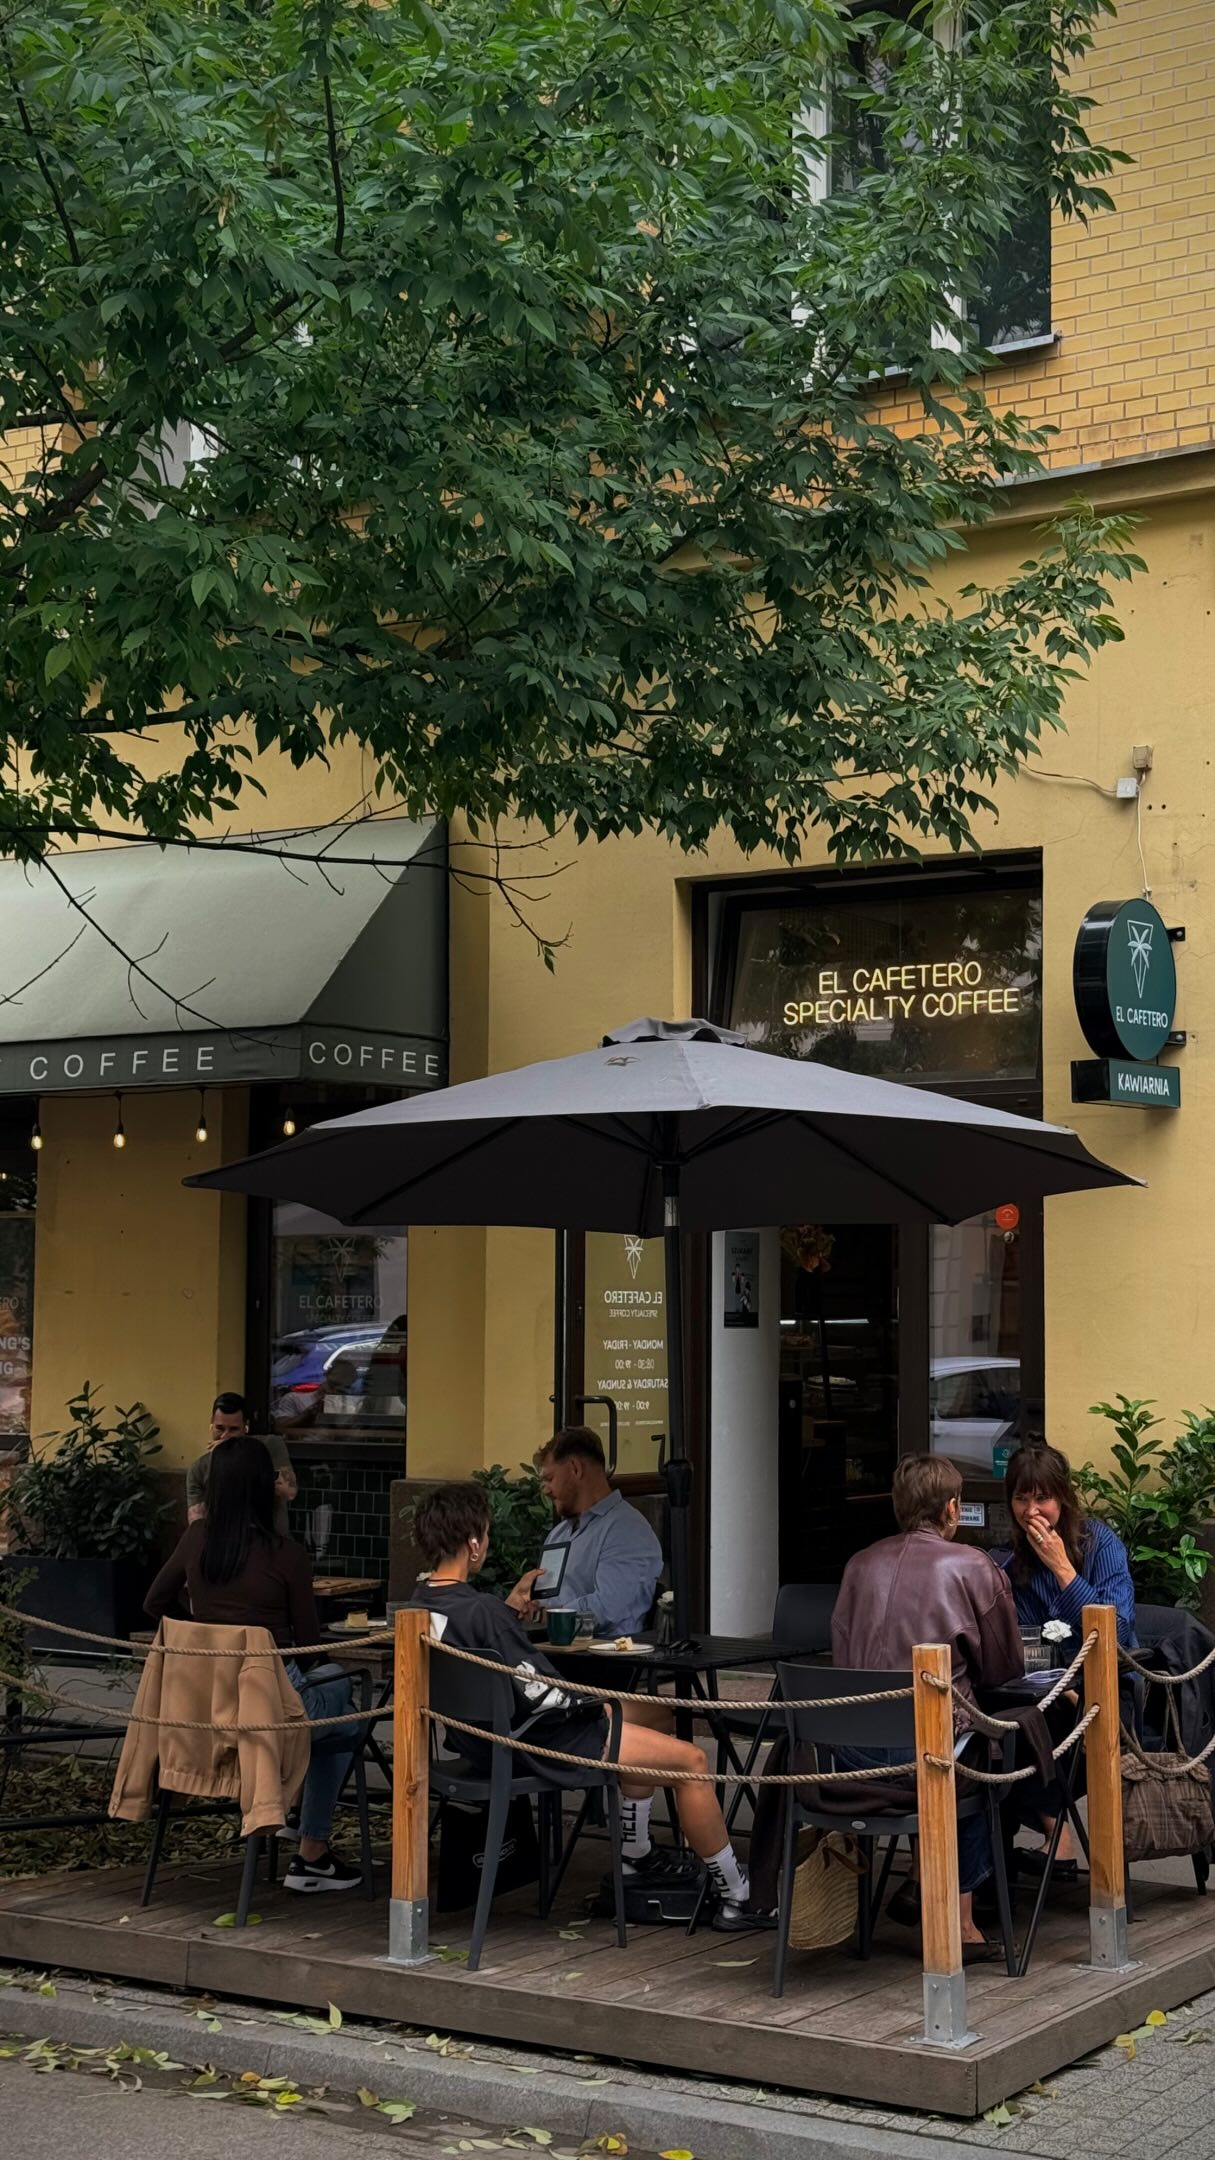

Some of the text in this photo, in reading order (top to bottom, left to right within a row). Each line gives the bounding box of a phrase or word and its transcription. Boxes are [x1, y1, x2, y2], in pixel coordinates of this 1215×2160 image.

[818, 960, 983, 995] EL CAFETERO
[782, 987, 1020, 1026] SPECIALTY COFFEE
[1116, 1006, 1168, 1028] EL CAFETERO
[29, 1045, 215, 1081] COFFEE
[308, 1041, 440, 1076] COFFEE
[1118, 1072, 1170, 1096] KAWIARNIA
[299, 1295, 384, 1309] EL CAFETERO
